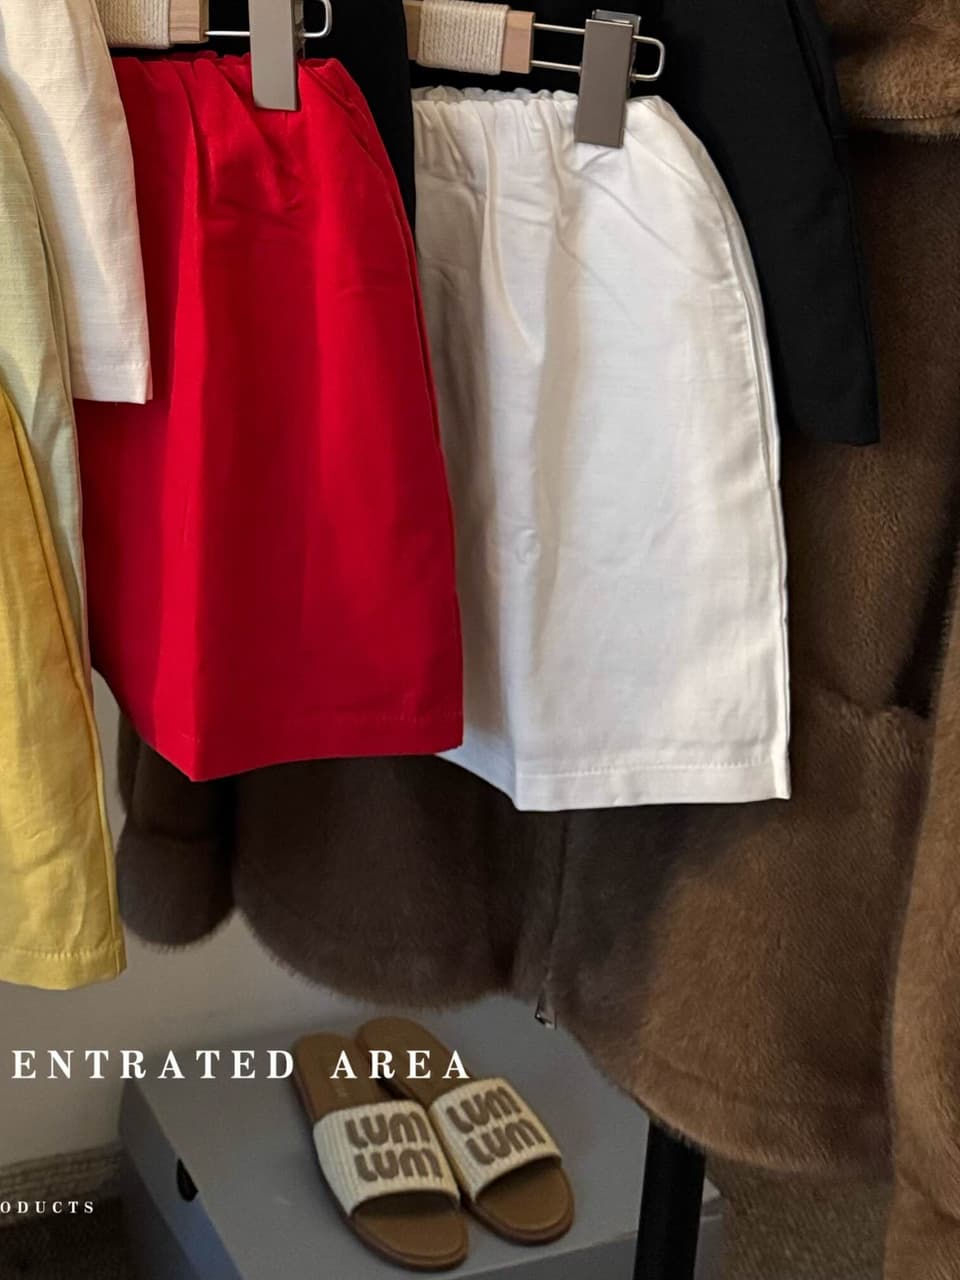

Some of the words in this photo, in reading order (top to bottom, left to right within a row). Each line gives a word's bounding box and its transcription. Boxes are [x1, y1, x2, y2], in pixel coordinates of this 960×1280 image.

[344, 1111, 431, 1149] LUM
[446, 1086, 522, 1135] LUM
[465, 1118, 547, 1166] LUM
[354, 1147, 443, 1183] LUM
